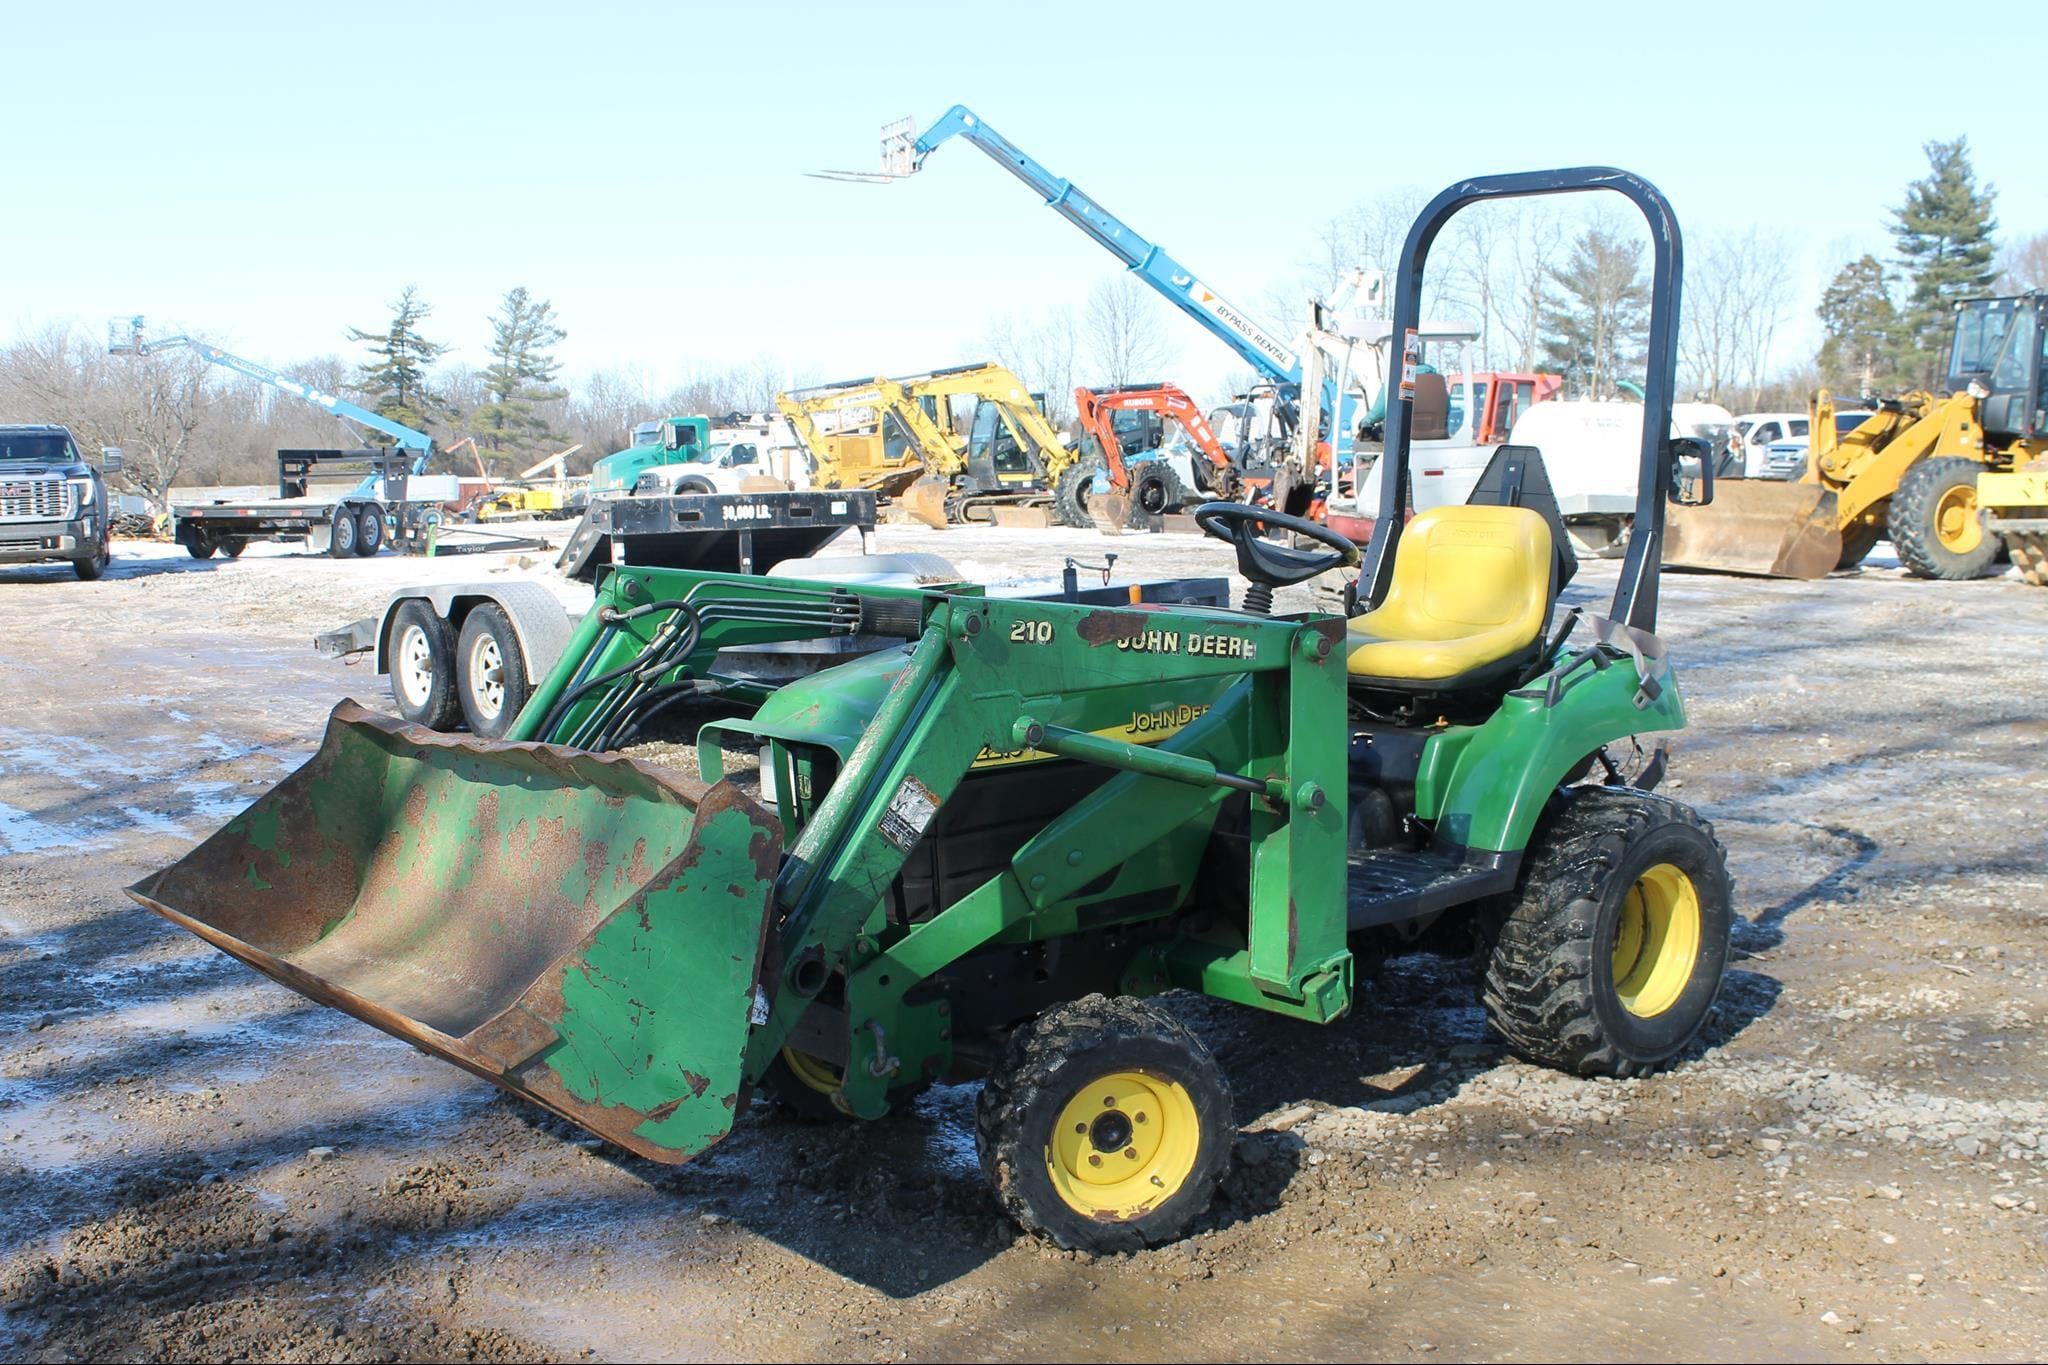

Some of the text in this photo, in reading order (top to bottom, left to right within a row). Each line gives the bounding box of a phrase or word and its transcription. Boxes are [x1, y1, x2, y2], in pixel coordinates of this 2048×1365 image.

[1217, 305, 1288, 365] BYPASS RENTAL
[1123, 398, 1154, 406] KUBOTA
[722, 504, 772, 521] 30,000 LB.
[456, 545, 487, 553] Taylor
[1010, 620, 1053, 643] 210
[1187, 634, 1256, 659] DEERE
[1126, 709, 1176, 733] JOHN
